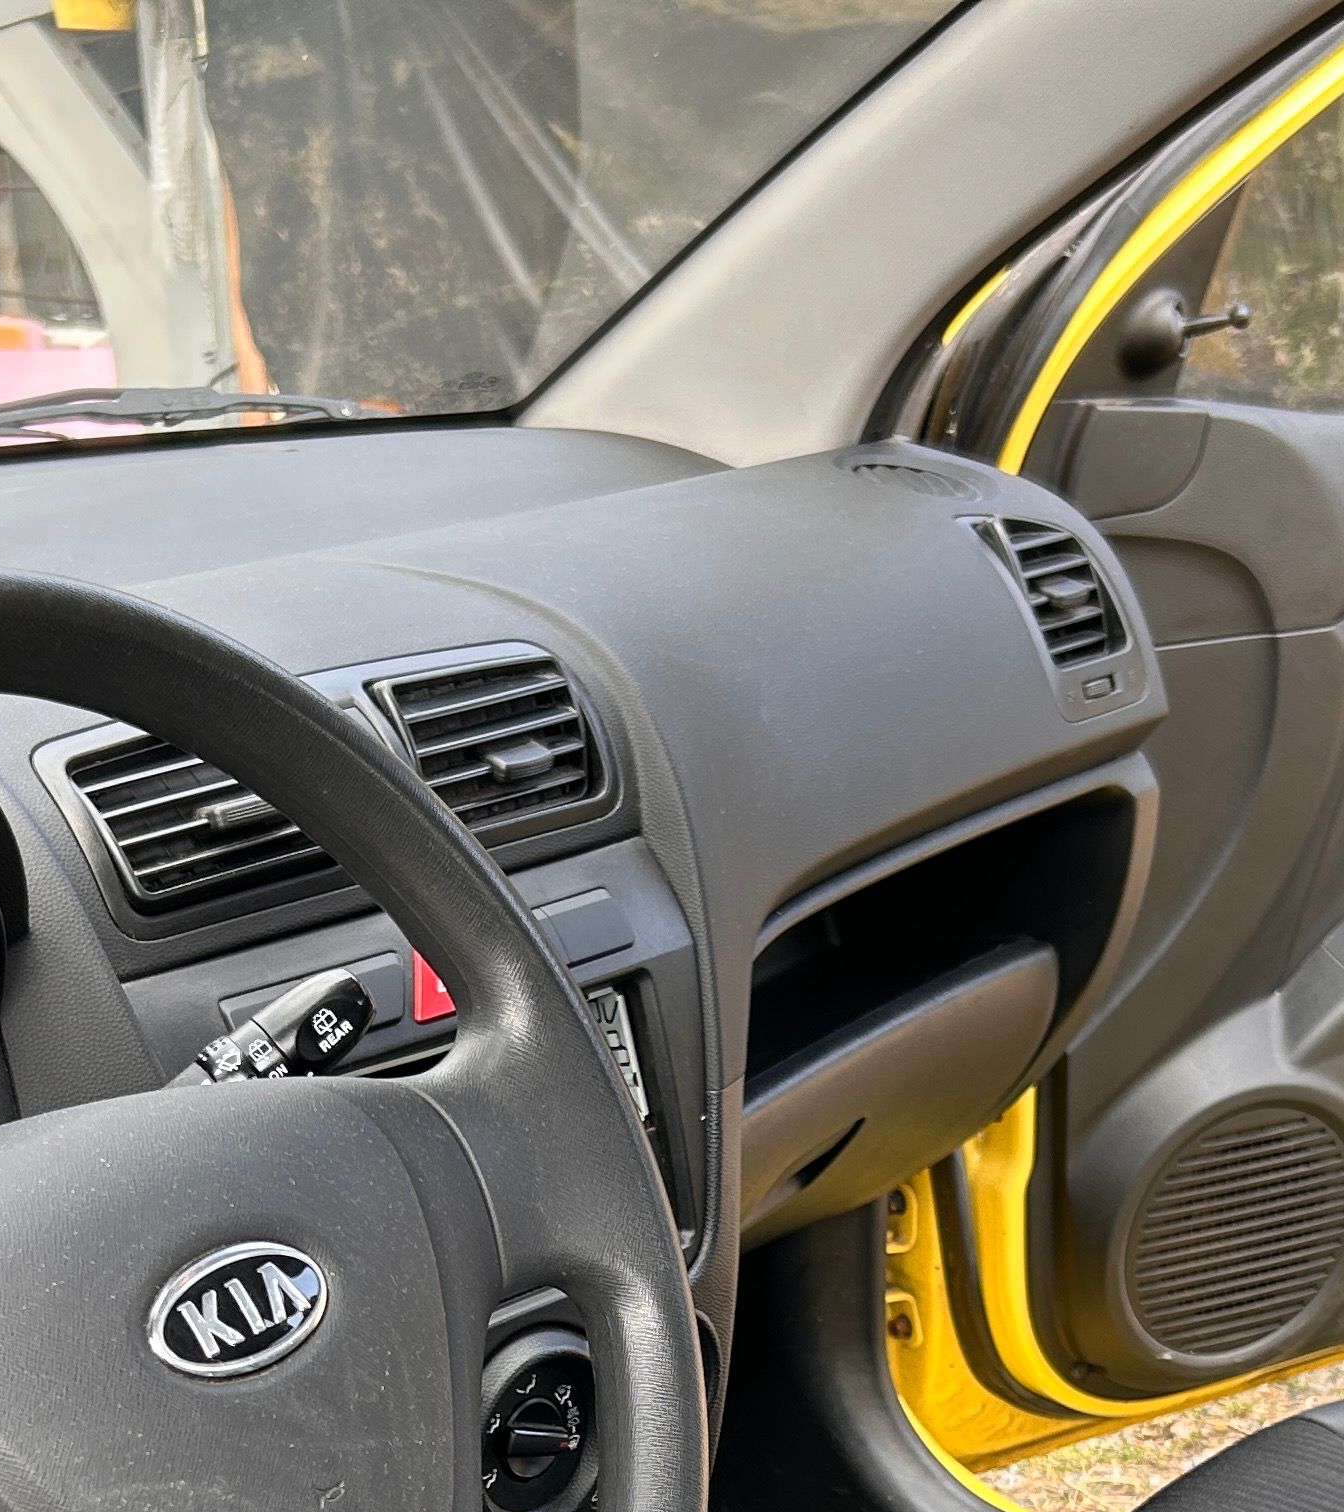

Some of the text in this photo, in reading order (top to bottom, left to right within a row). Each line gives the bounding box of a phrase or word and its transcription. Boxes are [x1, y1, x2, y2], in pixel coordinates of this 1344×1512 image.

[318, 1020, 354, 1053] REAR
[268, 1064, 289, 1079] ON
[176, 1261, 312, 1359] KIA
